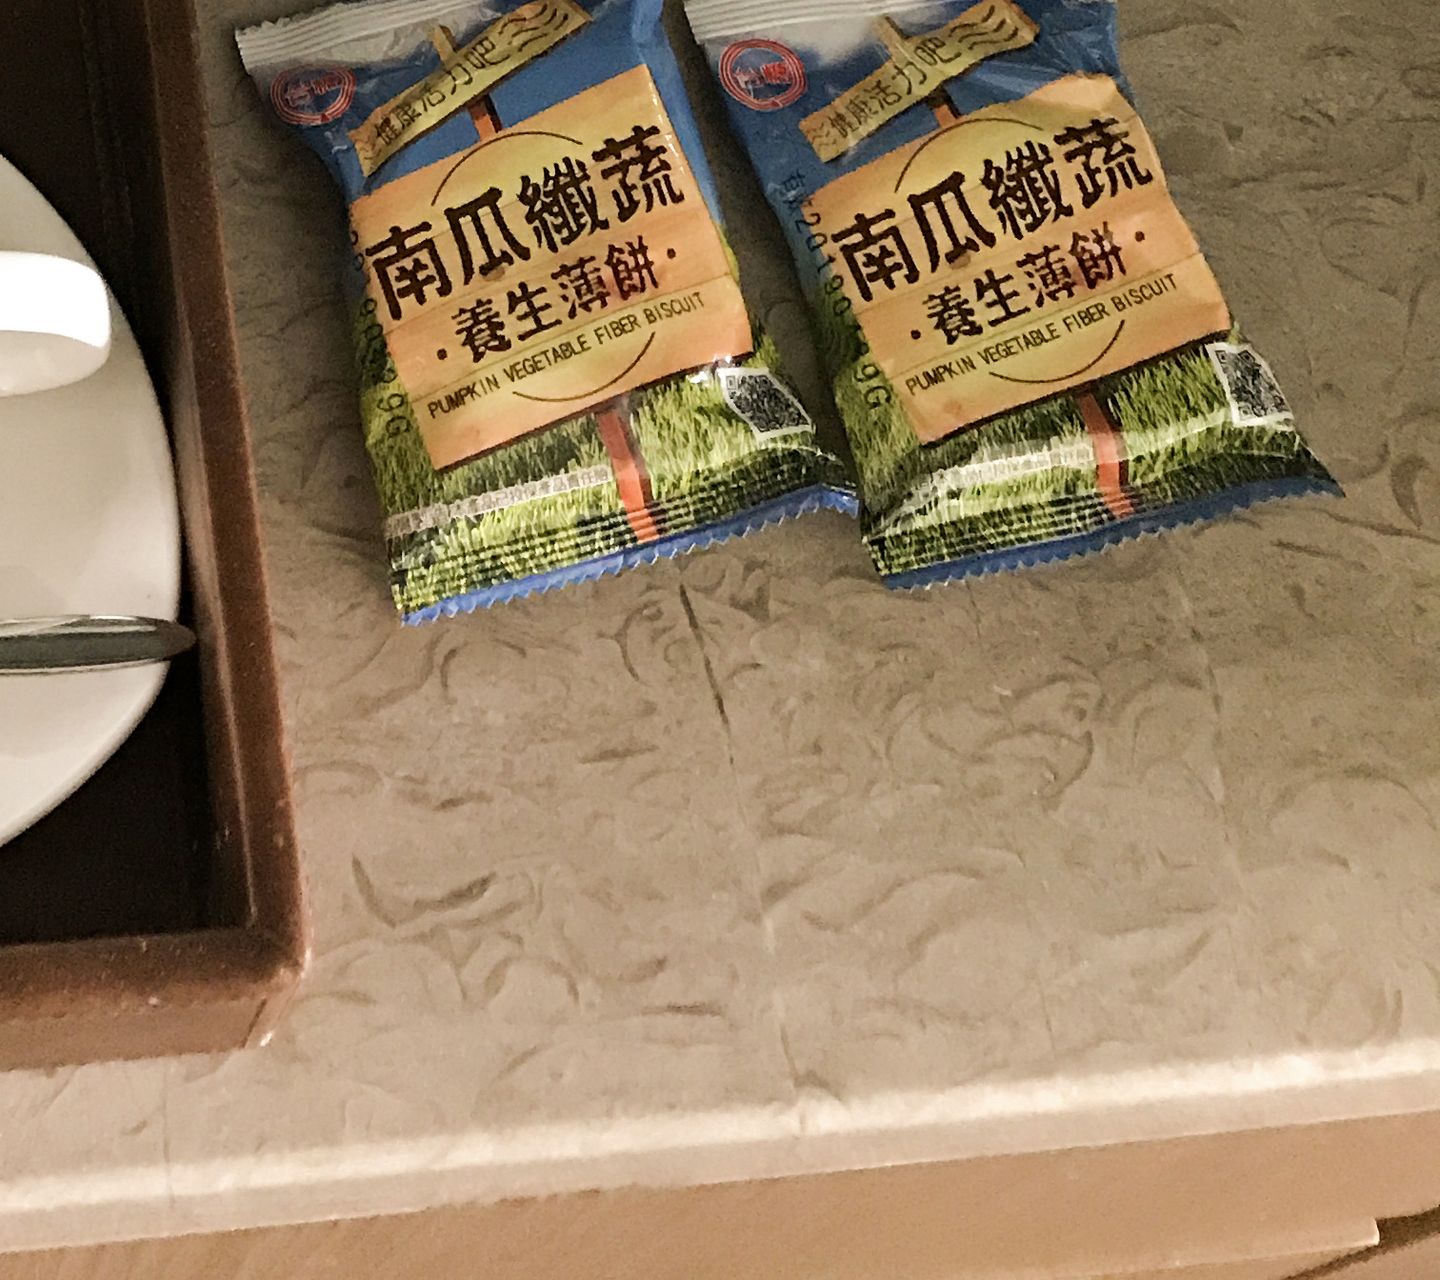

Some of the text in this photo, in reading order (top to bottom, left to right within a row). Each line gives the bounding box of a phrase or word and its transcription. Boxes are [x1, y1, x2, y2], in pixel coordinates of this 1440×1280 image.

[829, 25, 963, 138] 健康活力吧
[367, 125, 684, 321] 南瓜纖蔬
[833, 117, 1154, 303] 南瓜纖蔬
[452, 234, 659, 363] 養生薄餅
[905, 273, 1178, 396] PUMPKIN VEGETABLE FIBER BISCUIT
[922, 221, 1127, 345] 養生薄餅
[428, 291, 705, 419] PUMPKIN VEGETABLE FIBER BISCUIT
